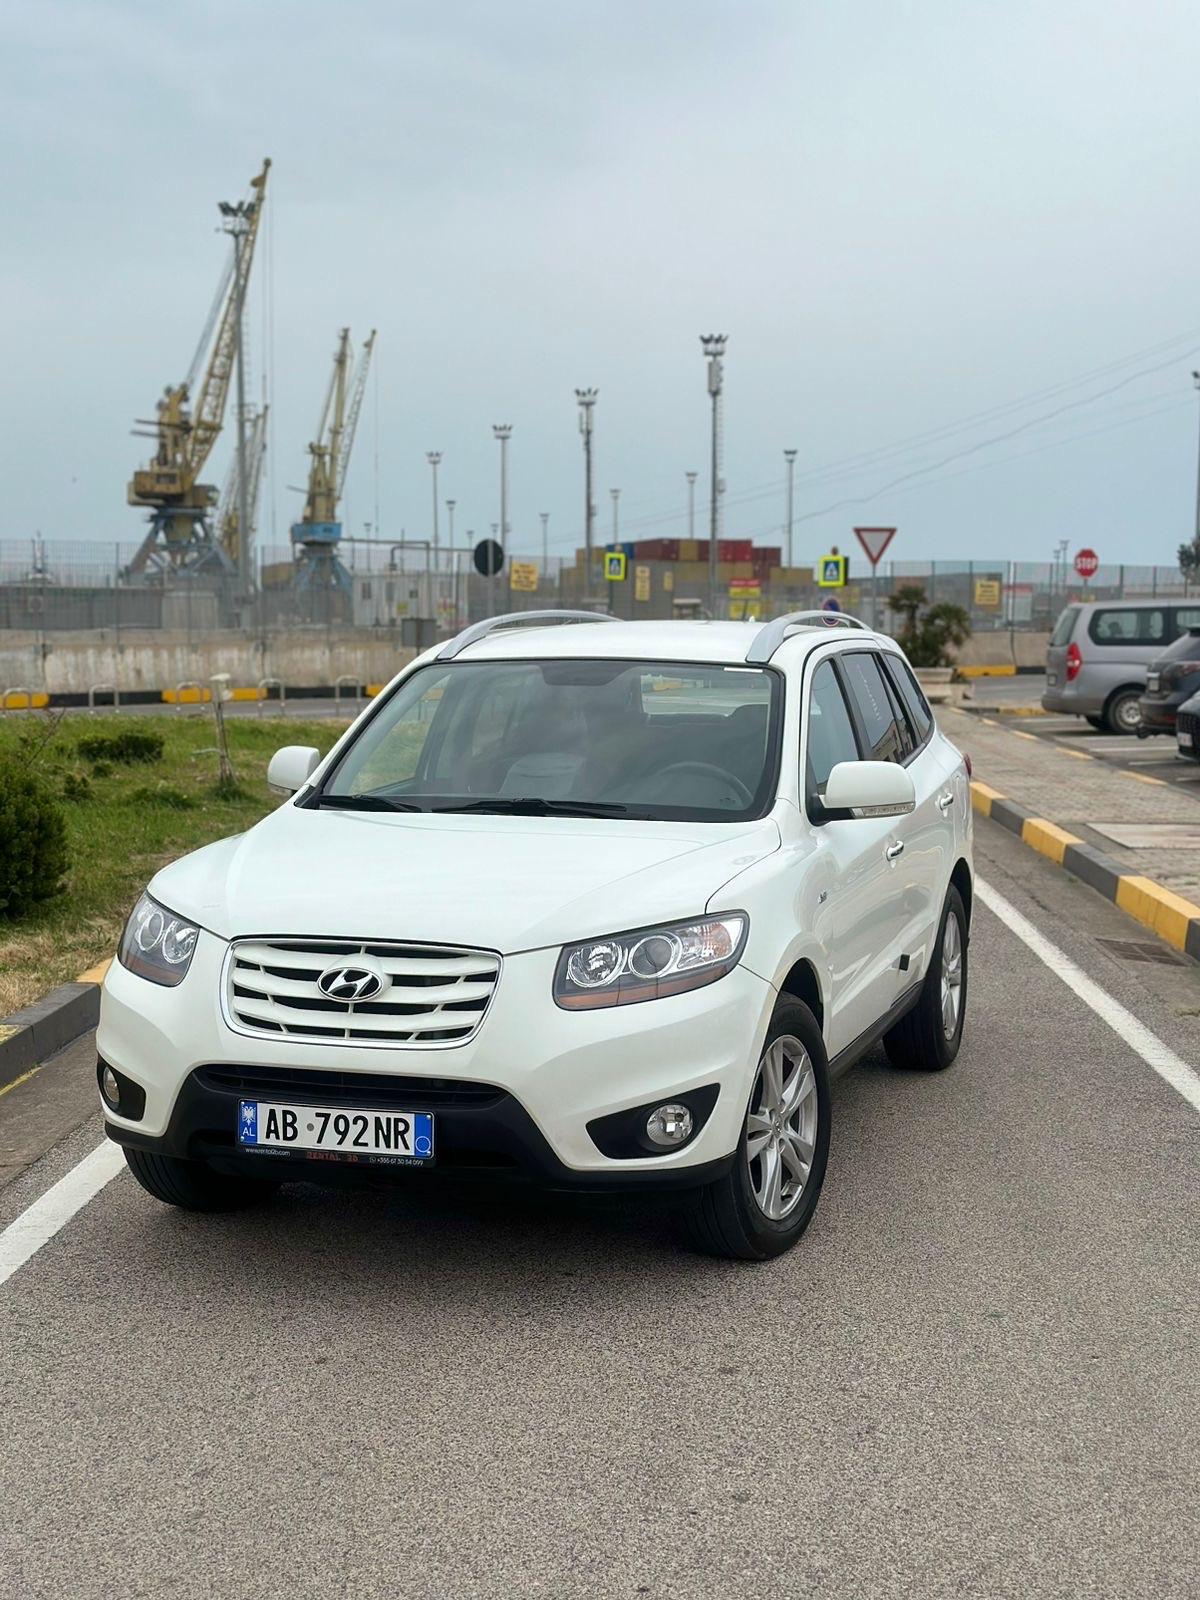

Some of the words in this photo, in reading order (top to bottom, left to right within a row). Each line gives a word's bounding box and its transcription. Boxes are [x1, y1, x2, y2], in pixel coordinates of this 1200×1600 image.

[1076, 557, 1097, 569] STOP
[265, 1108, 298, 1141] AB
[242, 1127, 256, 1137] AL
